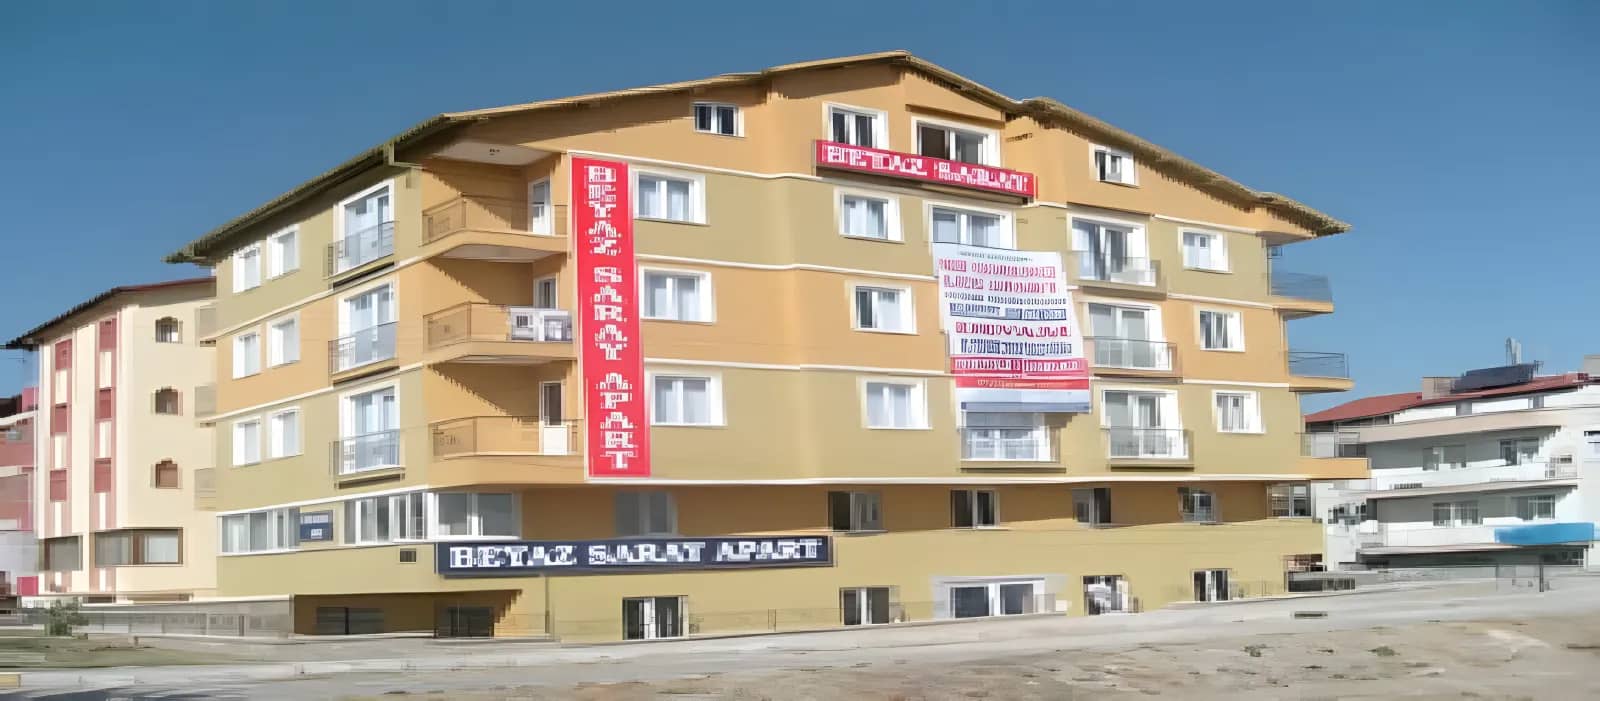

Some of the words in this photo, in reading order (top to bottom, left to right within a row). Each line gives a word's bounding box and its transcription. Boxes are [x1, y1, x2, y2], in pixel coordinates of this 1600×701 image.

[585, 165, 621, 256] BEYAZ
[593, 266, 628, 360] SARAY
[598, 372, 637, 469] APART
[449, 545, 577, 568] BEYAZ
[588, 541, 706, 566] SARAY
[713, 538, 822, 562] APART
